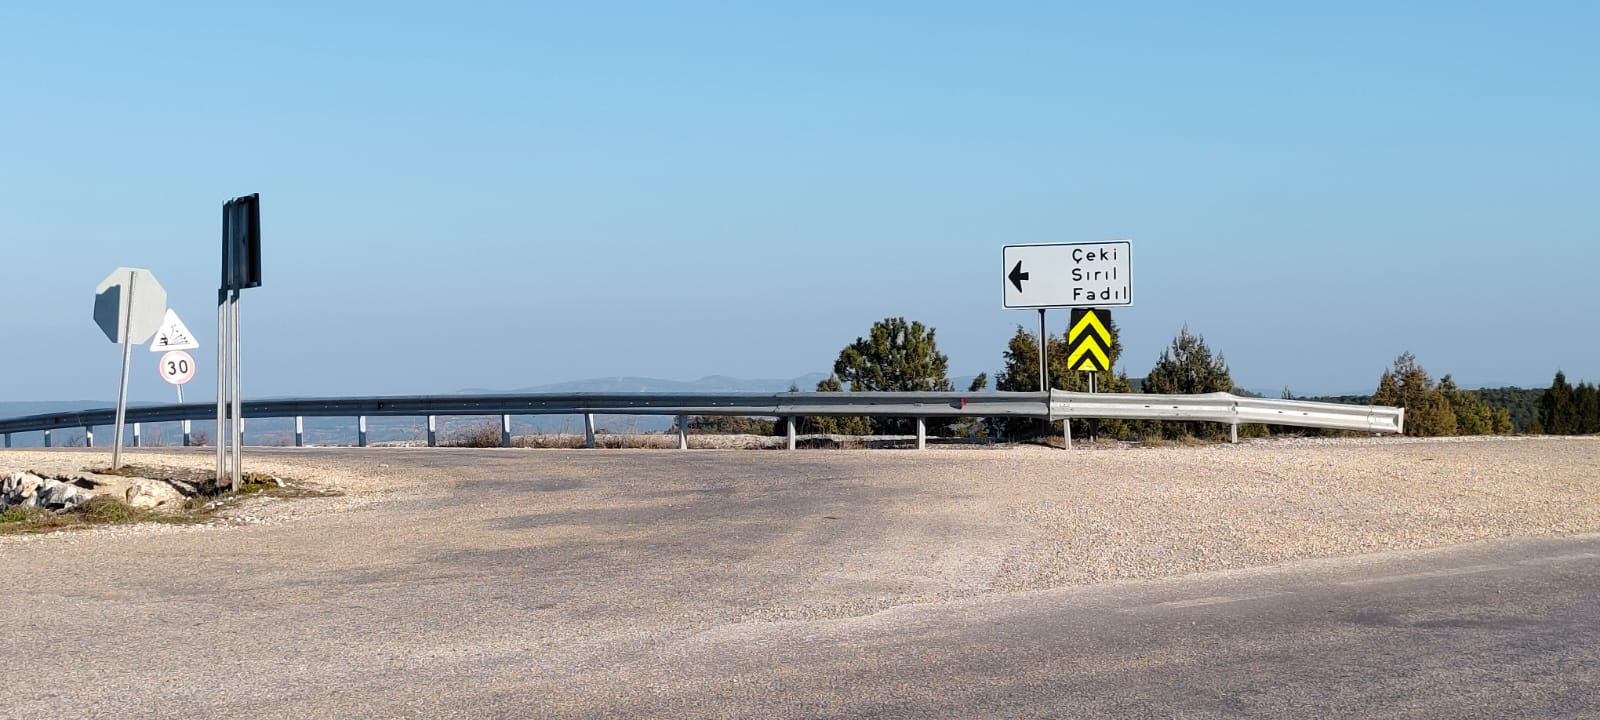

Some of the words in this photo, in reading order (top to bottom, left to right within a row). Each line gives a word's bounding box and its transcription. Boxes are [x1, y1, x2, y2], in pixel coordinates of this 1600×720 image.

[1072, 248, 1117, 264] Çeki
[1071, 267, 1117, 281] Sırıl
[1073, 286, 1127, 301] Fadıl
[167, 359, 188, 376] 30
